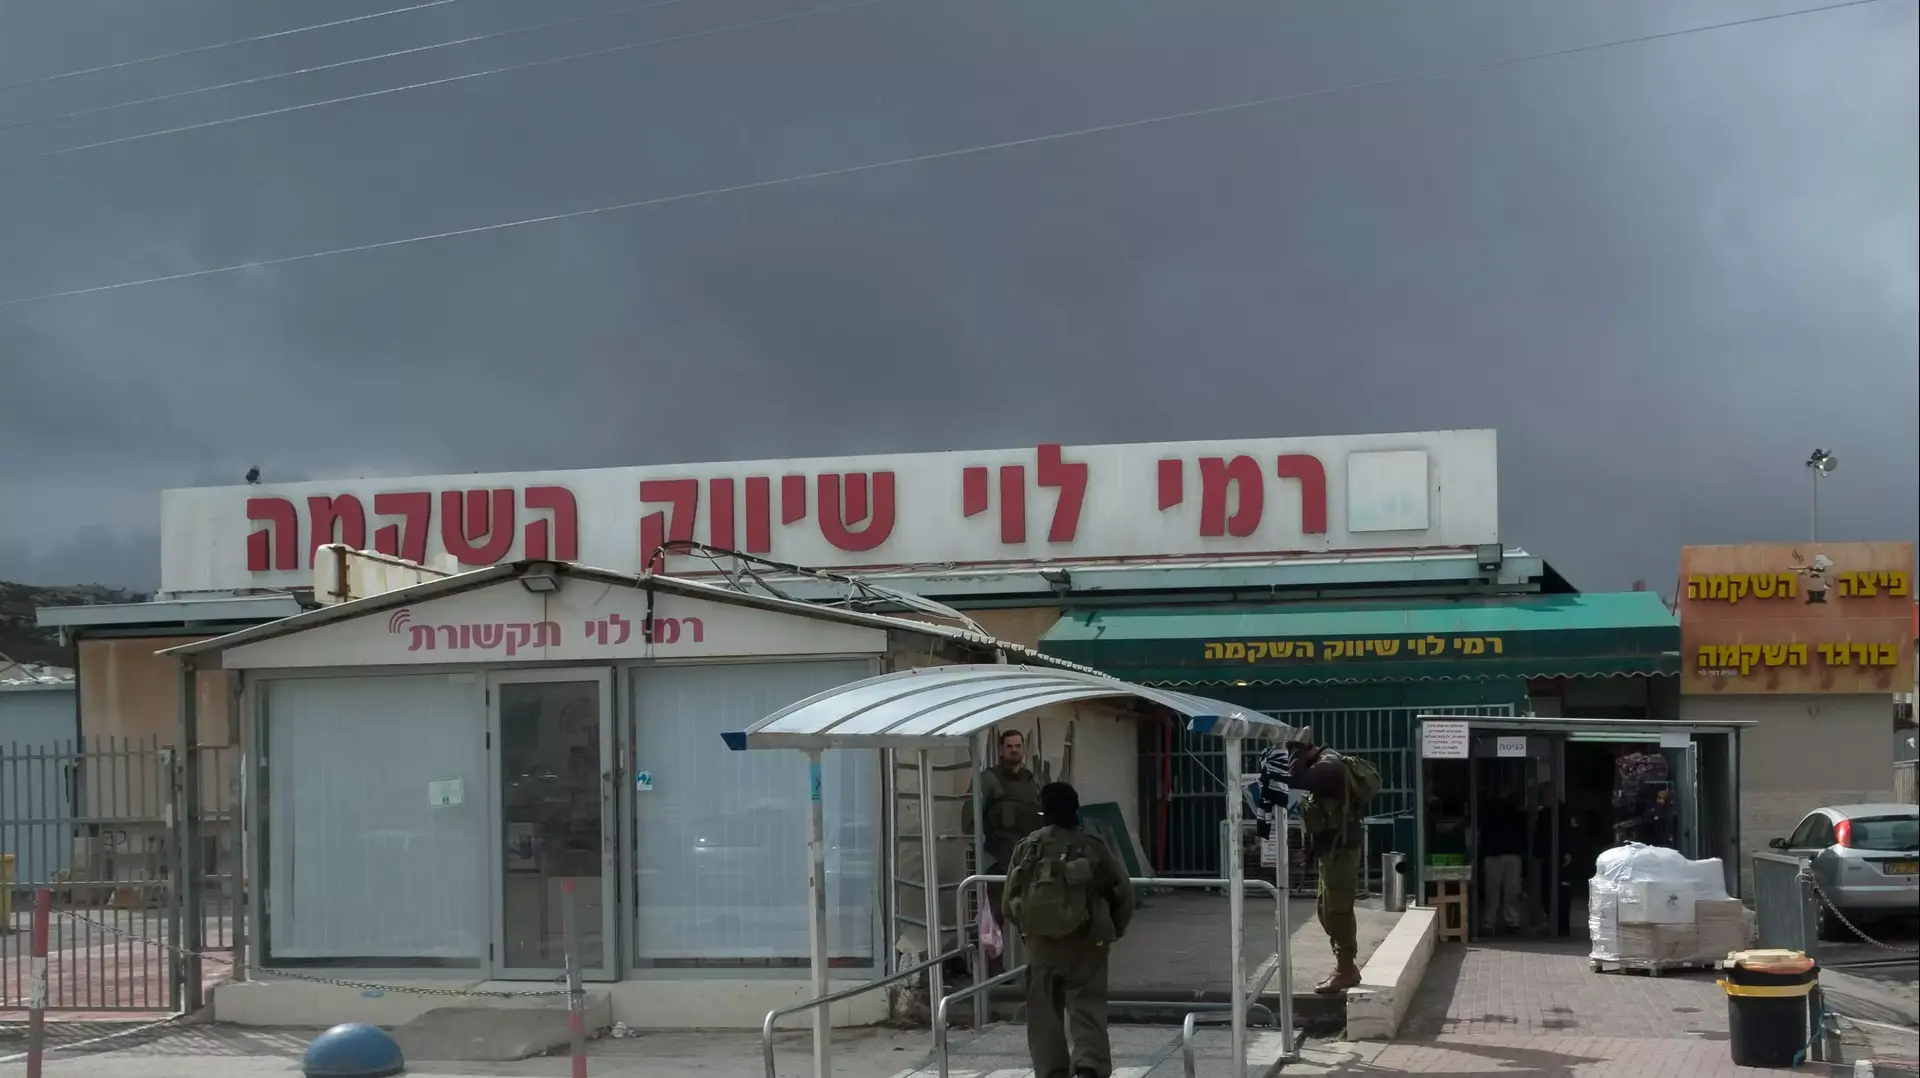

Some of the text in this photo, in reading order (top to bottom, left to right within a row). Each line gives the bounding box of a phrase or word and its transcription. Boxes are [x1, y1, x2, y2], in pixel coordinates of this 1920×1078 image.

[247, 444, 1328, 576] רמי לוי שיווק השקמה
[1688, 571, 1908, 604] פיצה השקמה
[408, 620, 561, 656] תקשורת
[585, 613, 631, 645] לוי
[1204, 635, 1503, 663] רמי לוי שיווק השקמה
[1698, 643, 1898, 676] בורגר השקמה
